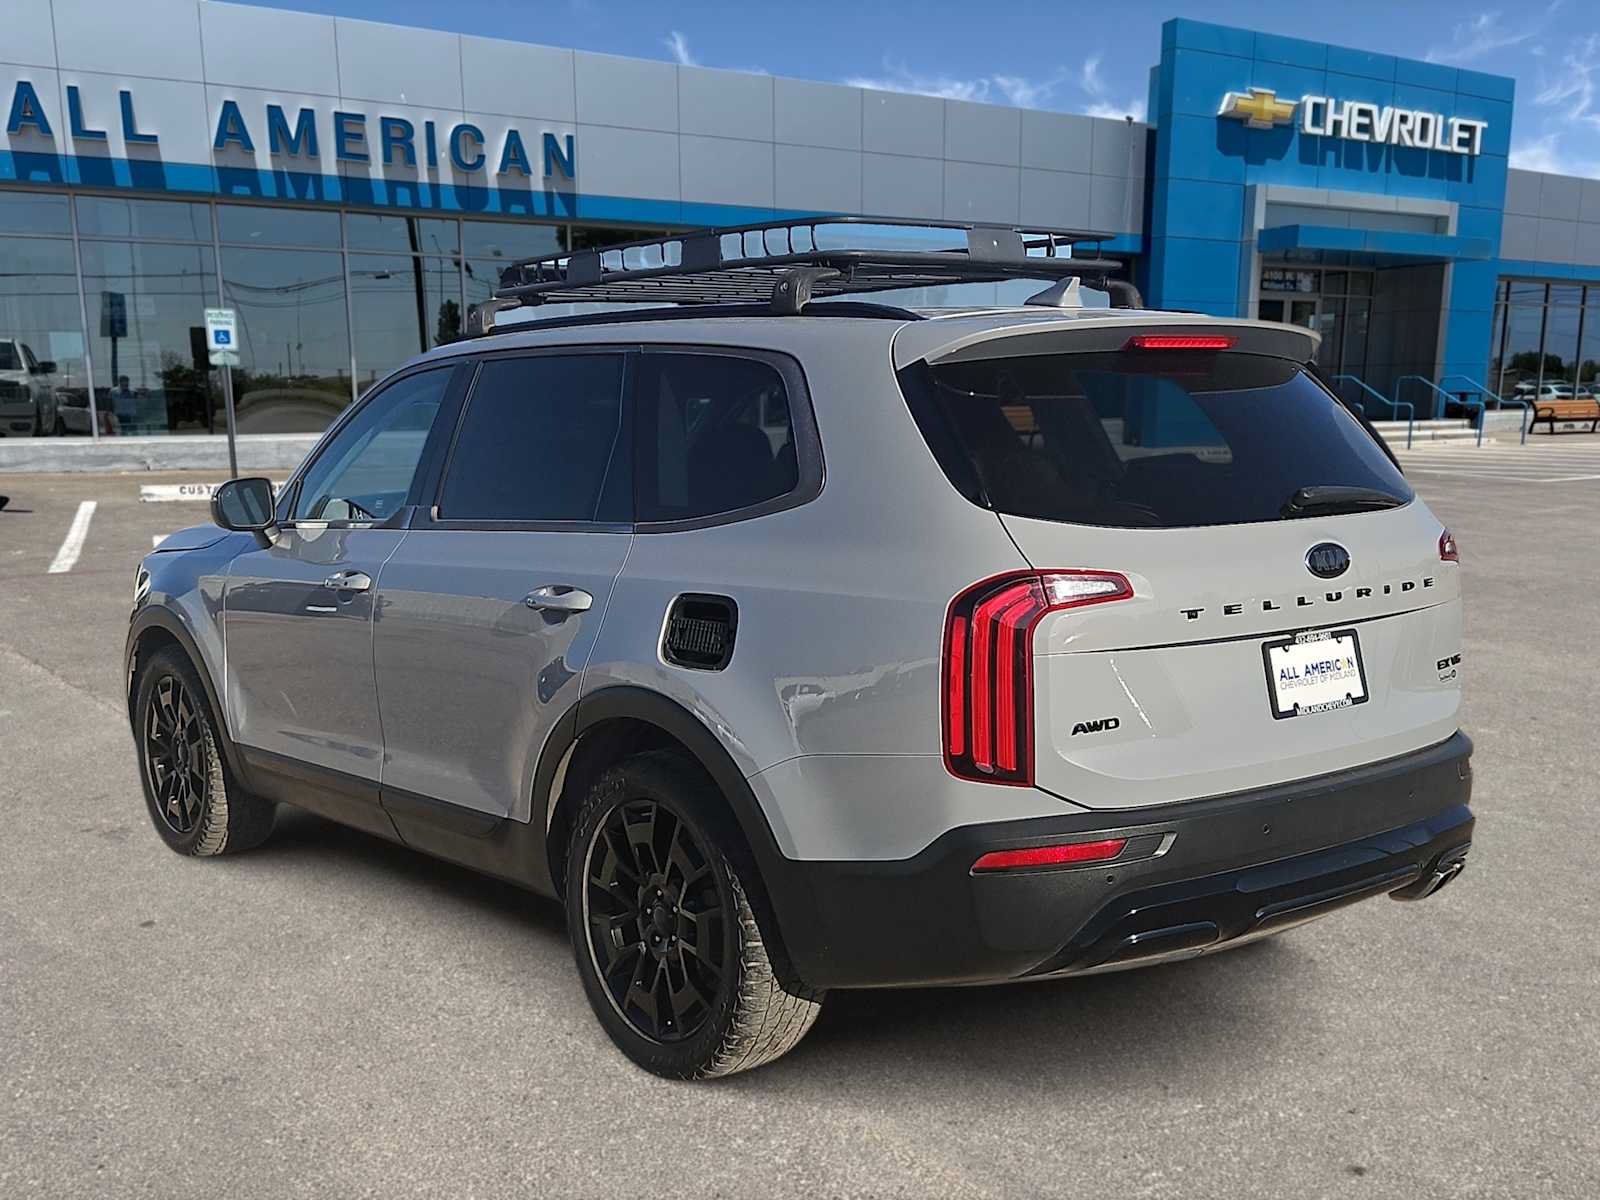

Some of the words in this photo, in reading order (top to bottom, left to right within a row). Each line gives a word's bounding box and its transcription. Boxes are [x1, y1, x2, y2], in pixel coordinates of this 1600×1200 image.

[7, 80, 159, 145] ALL
[213, 99, 576, 180] AMERICAN
[1301, 94, 1488, 156] CHEVROLET
[1181, 577, 1435, 621] TELLURIDE
[1280, 666, 1300, 681] ALL
[1280, 675, 1319, 690] CHEVROLET
[1319, 674, 1328, 683] OF
[1071, 717, 1120, 736] AWD
